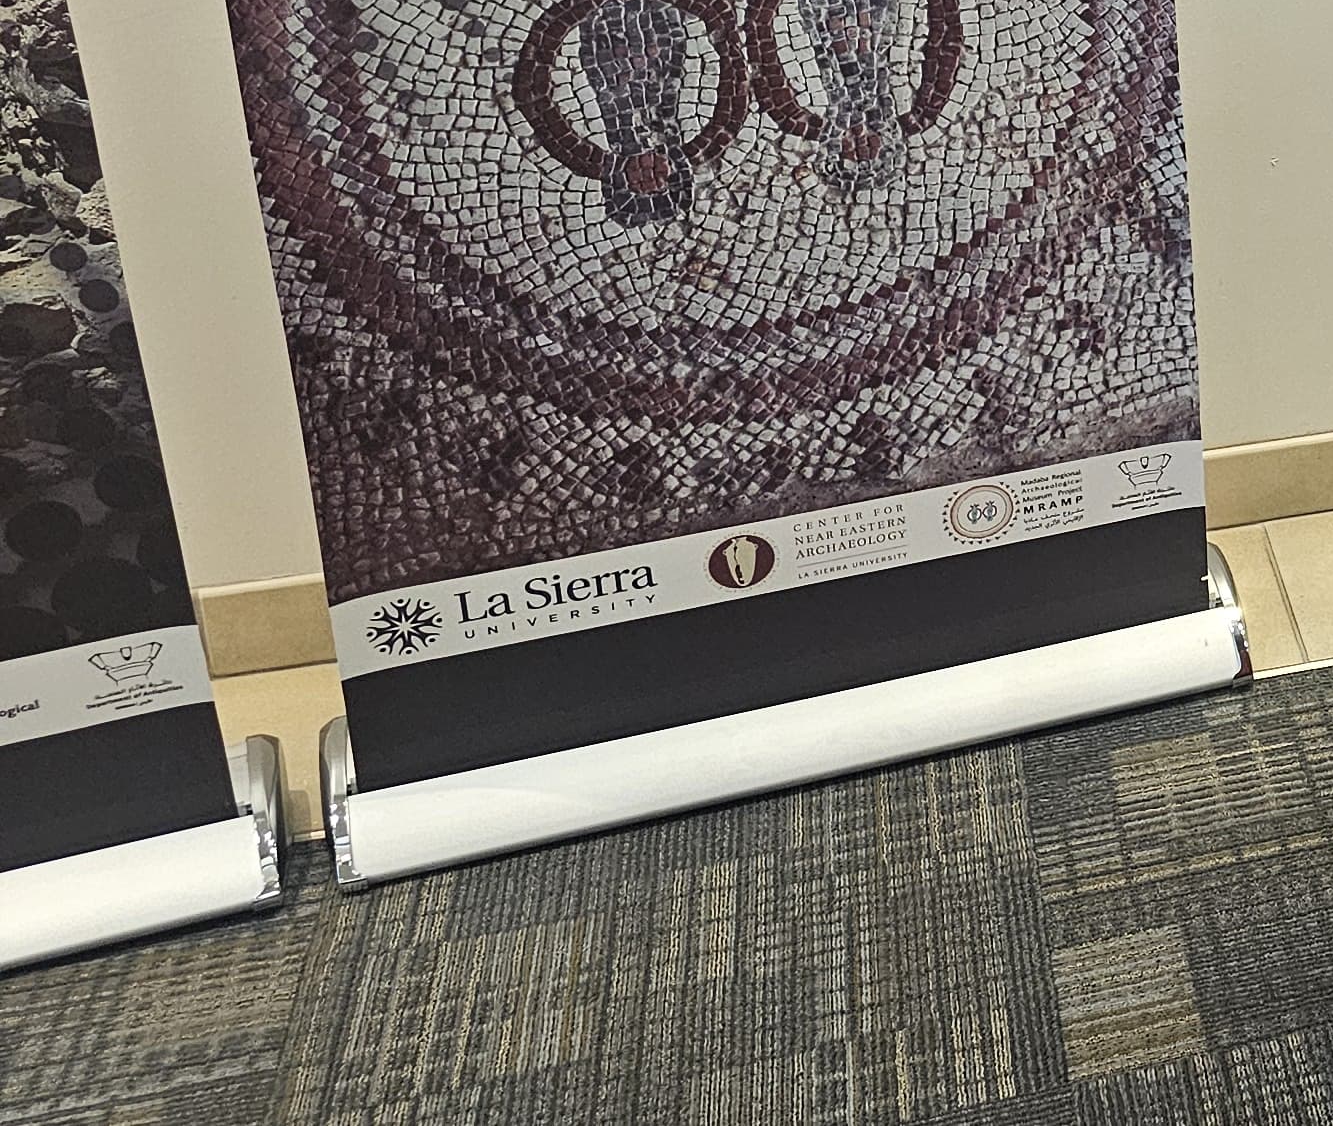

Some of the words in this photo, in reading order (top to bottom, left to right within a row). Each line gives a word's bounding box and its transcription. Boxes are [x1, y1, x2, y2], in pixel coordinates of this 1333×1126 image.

[1023, 493, 1053, 503] Museum
[1058, 486, 1083, 496] Project
[1024, 495, 1083, 514] MRAMP
[793, 511, 863, 532] CENTER
[874, 504, 904, 517] FOR
[795, 530, 834, 546] NEAR
[840, 516, 906, 537] EASTERN
[796, 529, 907, 560] ARCHAEOLOGY
[814, 564, 848, 576] SIERRA
[853, 552, 908, 569] UNIVERSITY
[454, 590, 517, 625] La
[526, 564, 659, 609] Sierra
[464, 593, 658, 640] UNIVERSITY
